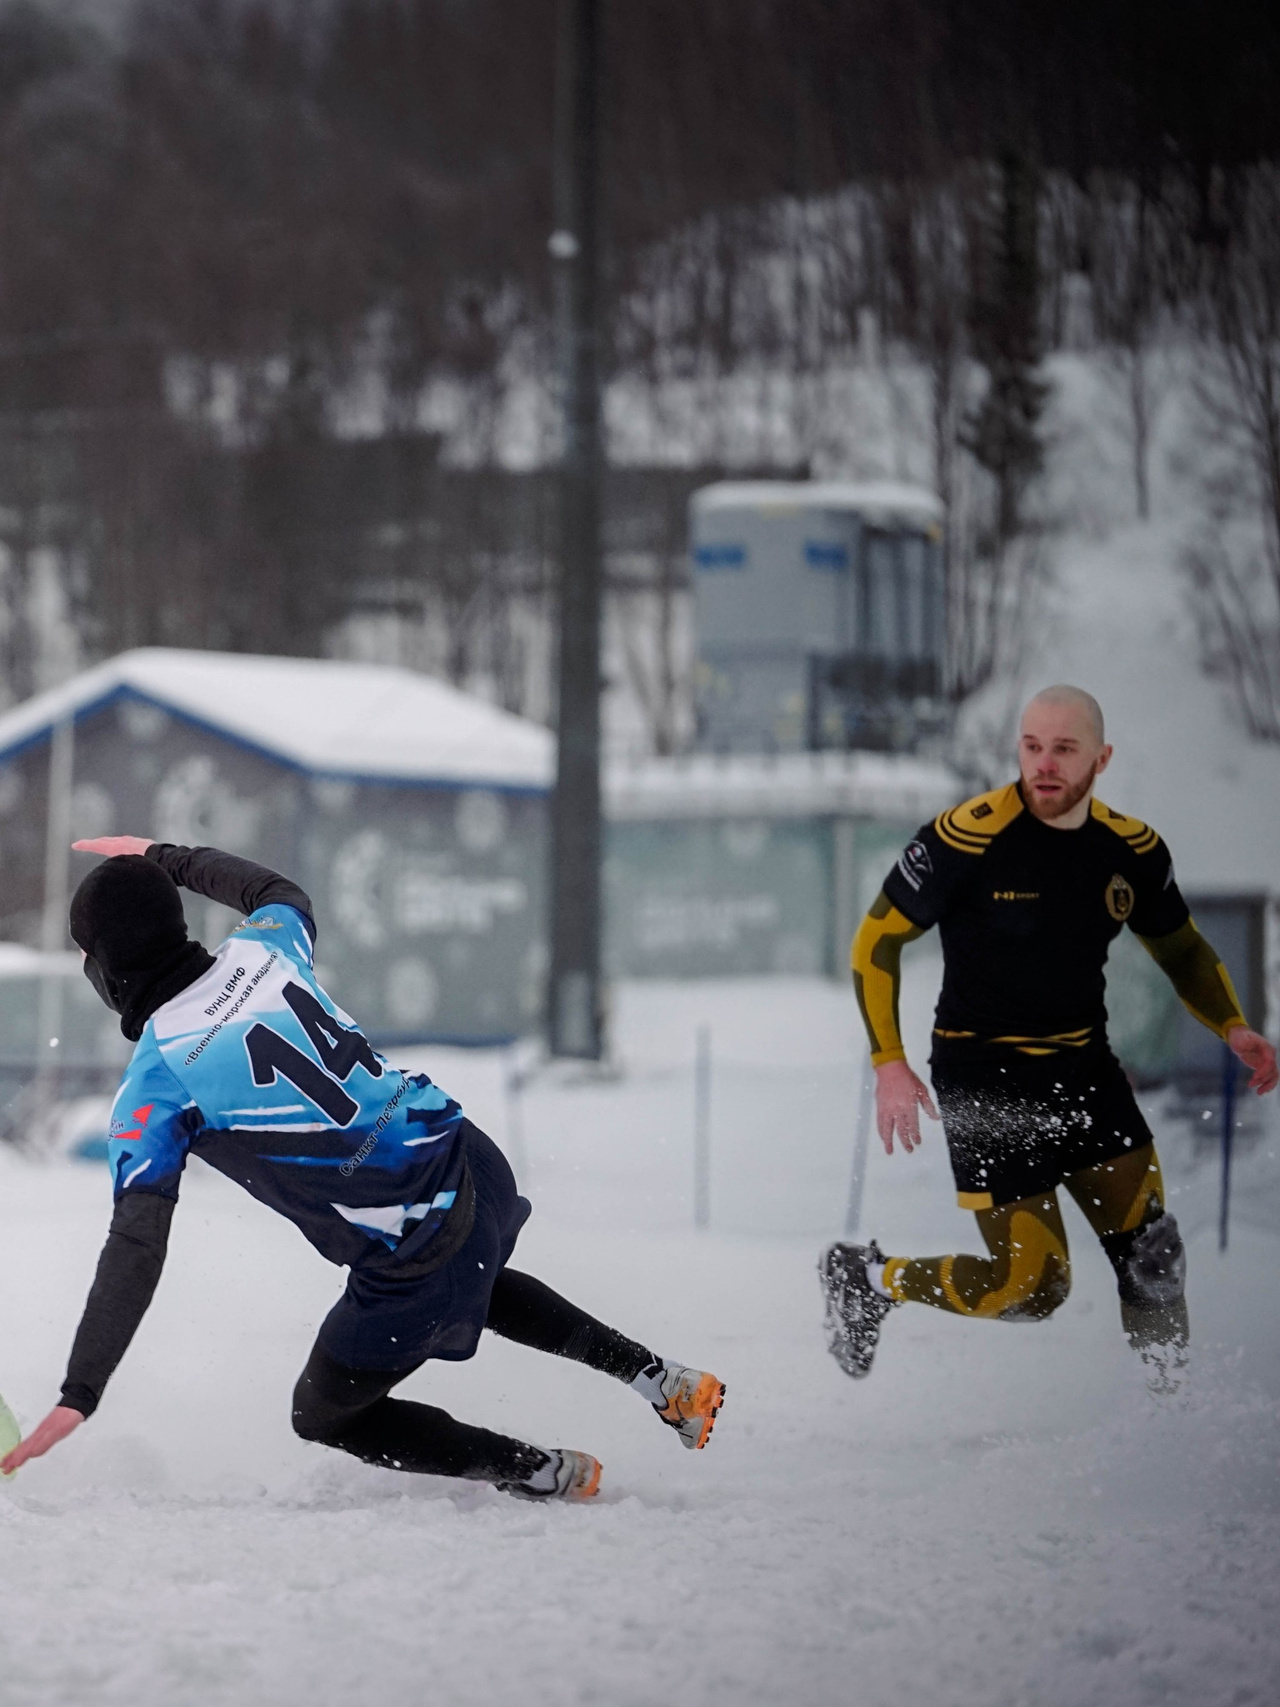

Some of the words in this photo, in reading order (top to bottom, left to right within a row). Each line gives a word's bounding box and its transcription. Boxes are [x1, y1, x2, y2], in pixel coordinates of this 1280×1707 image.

[184, 984, 255, 1066] «Военно-морская
[204, 992, 232, 1016] ВУНЦ
[225, 966, 246, 993] ВМФ
[242, 979, 384, 1130] 14
[339, 1074, 412, 1177] Санкт-Петербур
